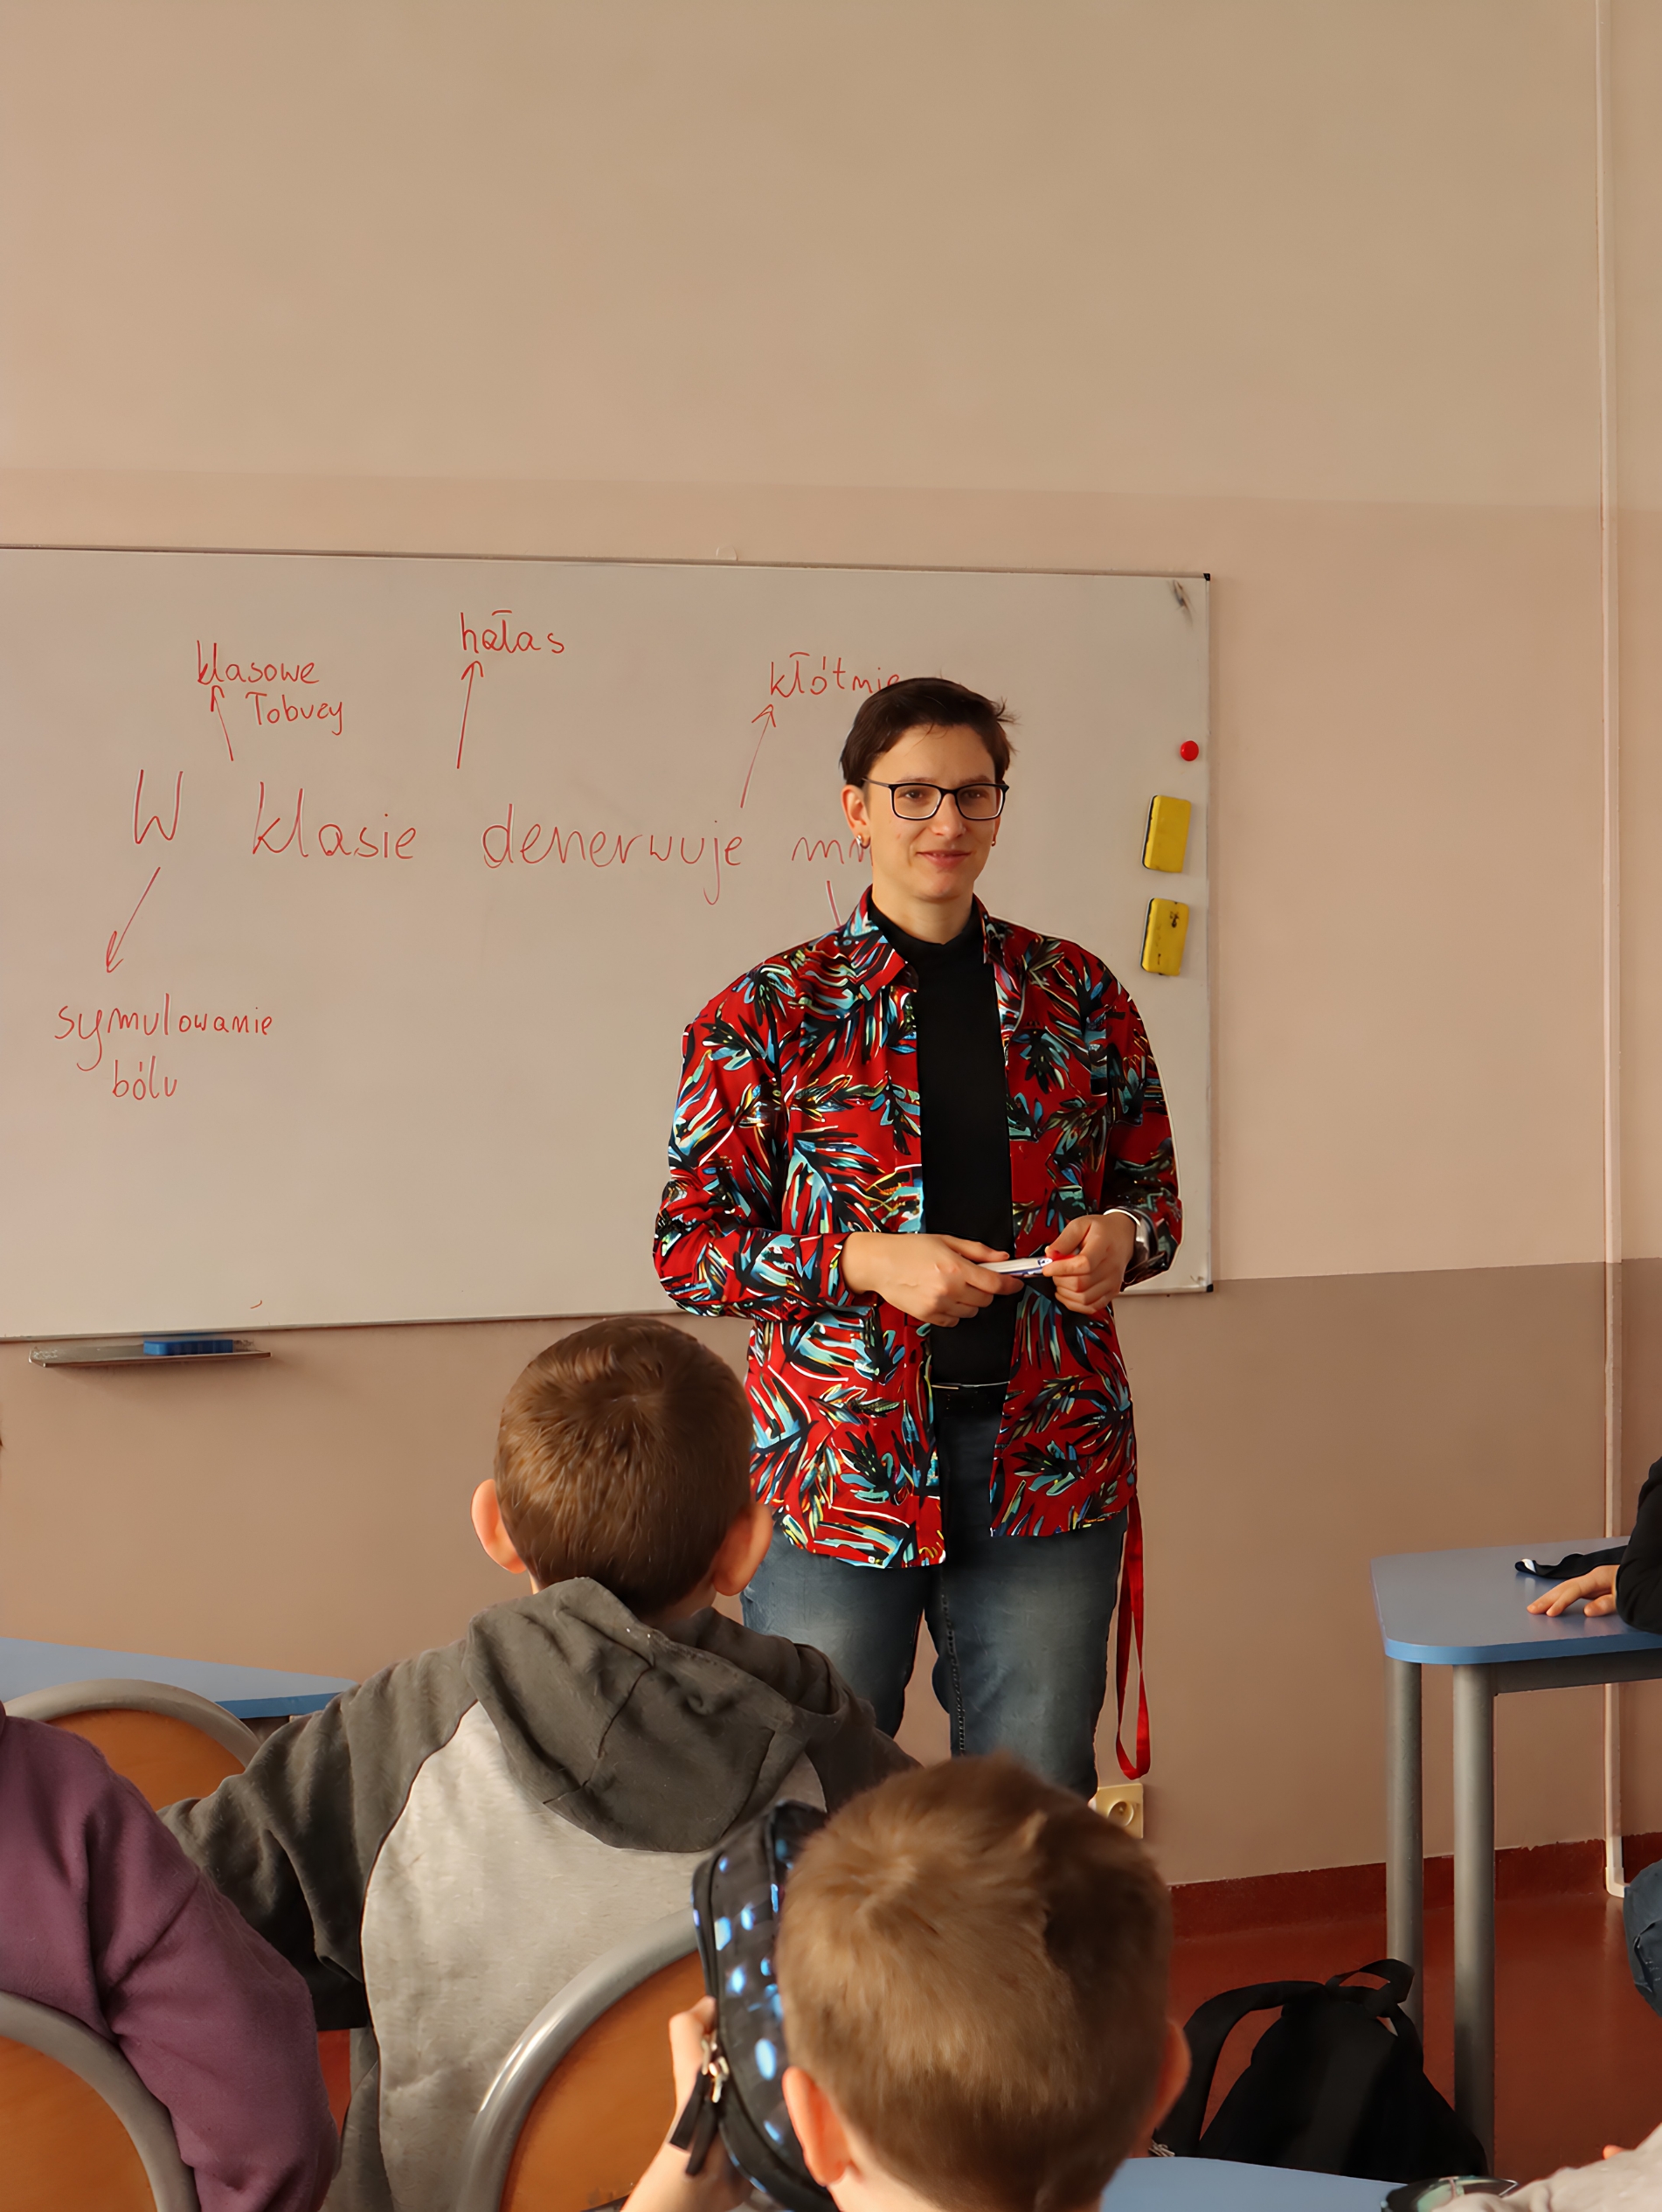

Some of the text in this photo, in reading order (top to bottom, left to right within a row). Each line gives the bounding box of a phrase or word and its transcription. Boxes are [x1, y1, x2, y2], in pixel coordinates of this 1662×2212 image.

[460, 609, 564, 654] hałas
[197, 639, 320, 686] klasowe
[133, 769, 184, 844] W
[252, 780, 417, 859] klasie
[481, 803, 743, 905] denerwuje
[54, 993, 273, 1071] symulowanie
[112, 1055, 177, 1100] bólu
